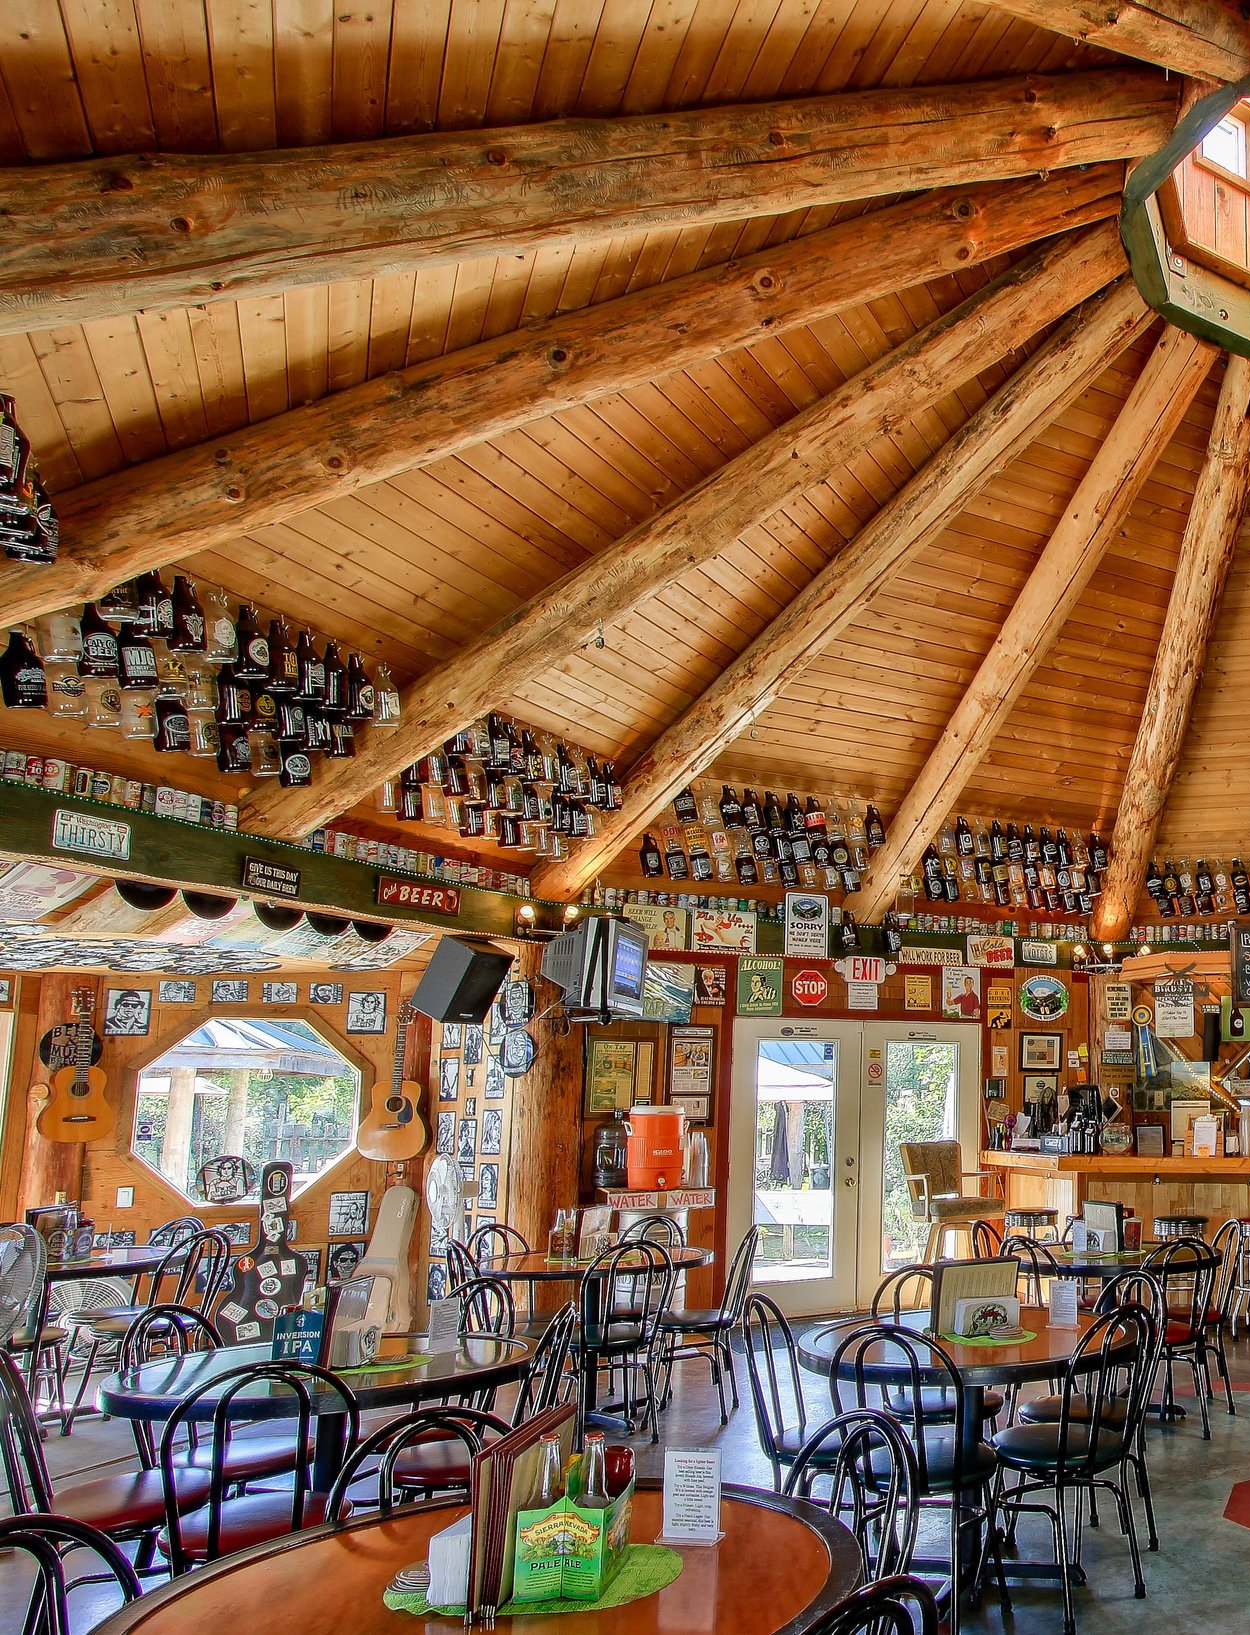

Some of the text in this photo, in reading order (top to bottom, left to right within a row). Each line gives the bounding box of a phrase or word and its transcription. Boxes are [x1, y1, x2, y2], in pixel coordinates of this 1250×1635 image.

[89, 648, 117, 657] BEER
[61, 822, 126, 852] THIRSTY
[249, 862, 264, 874] GIVE
[264, 866, 273, 876] US
[286, 871, 299, 882] DAY
[383, 883, 443, 907] Cold BEER
[790, 922, 824, 930] SORRY
[902, 950, 960, 963] WILL WORK FOR BEER
[986, 947, 1013, 963] BEER
[740, 960, 781, 971] ALCOHOL!
[852, 958, 880, 981] EXIT
[795, 980, 826, 995] STOP
[609, 1192, 712, 1209] WATER WATER
[277, 1331, 320, 1340] INVERSION
[283, 1341, 313, 1353] IPA
[535, 1521, 589, 1536] SIERRA NEVADA
[530, 1559, 581, 1571] PALE ALE
